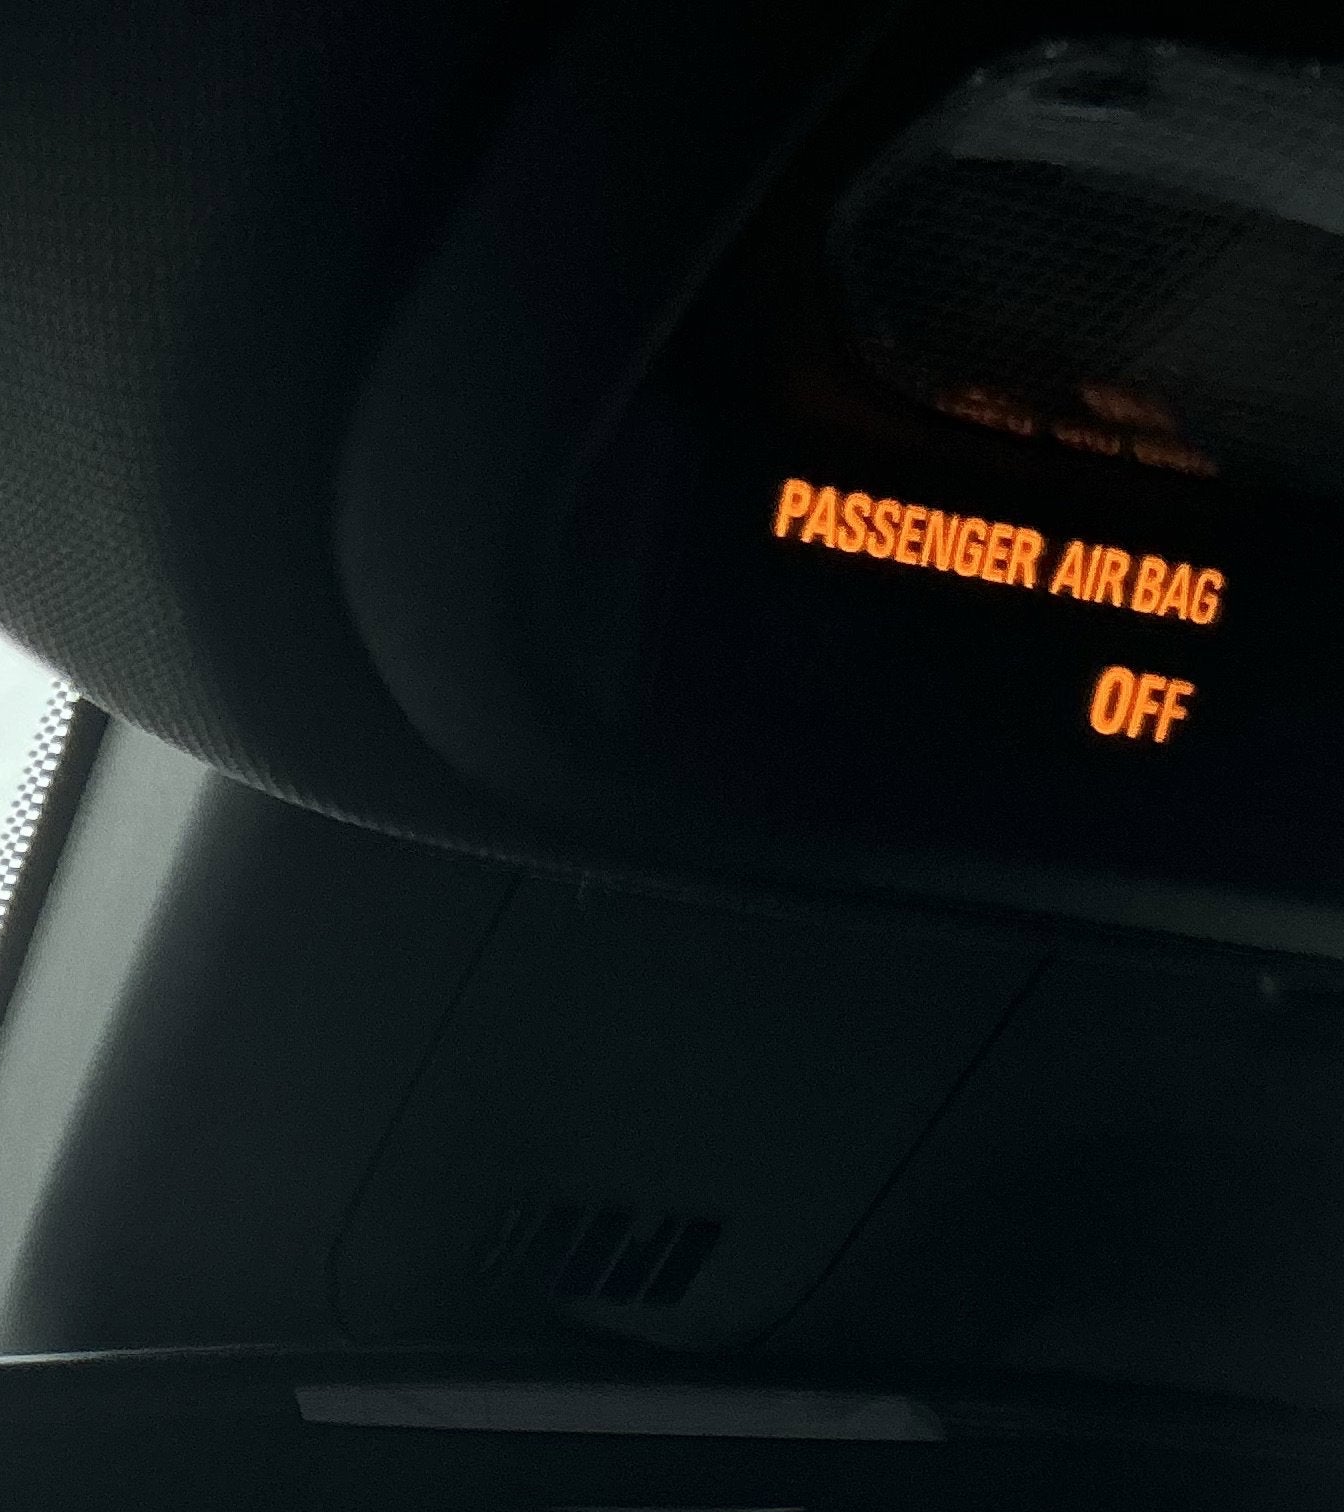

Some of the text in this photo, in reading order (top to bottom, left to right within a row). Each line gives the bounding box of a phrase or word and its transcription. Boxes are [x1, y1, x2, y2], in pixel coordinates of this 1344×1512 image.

[774, 477, 1226, 626] PASSENGER AIR BAG
[1088, 665, 1195, 743] OFF
